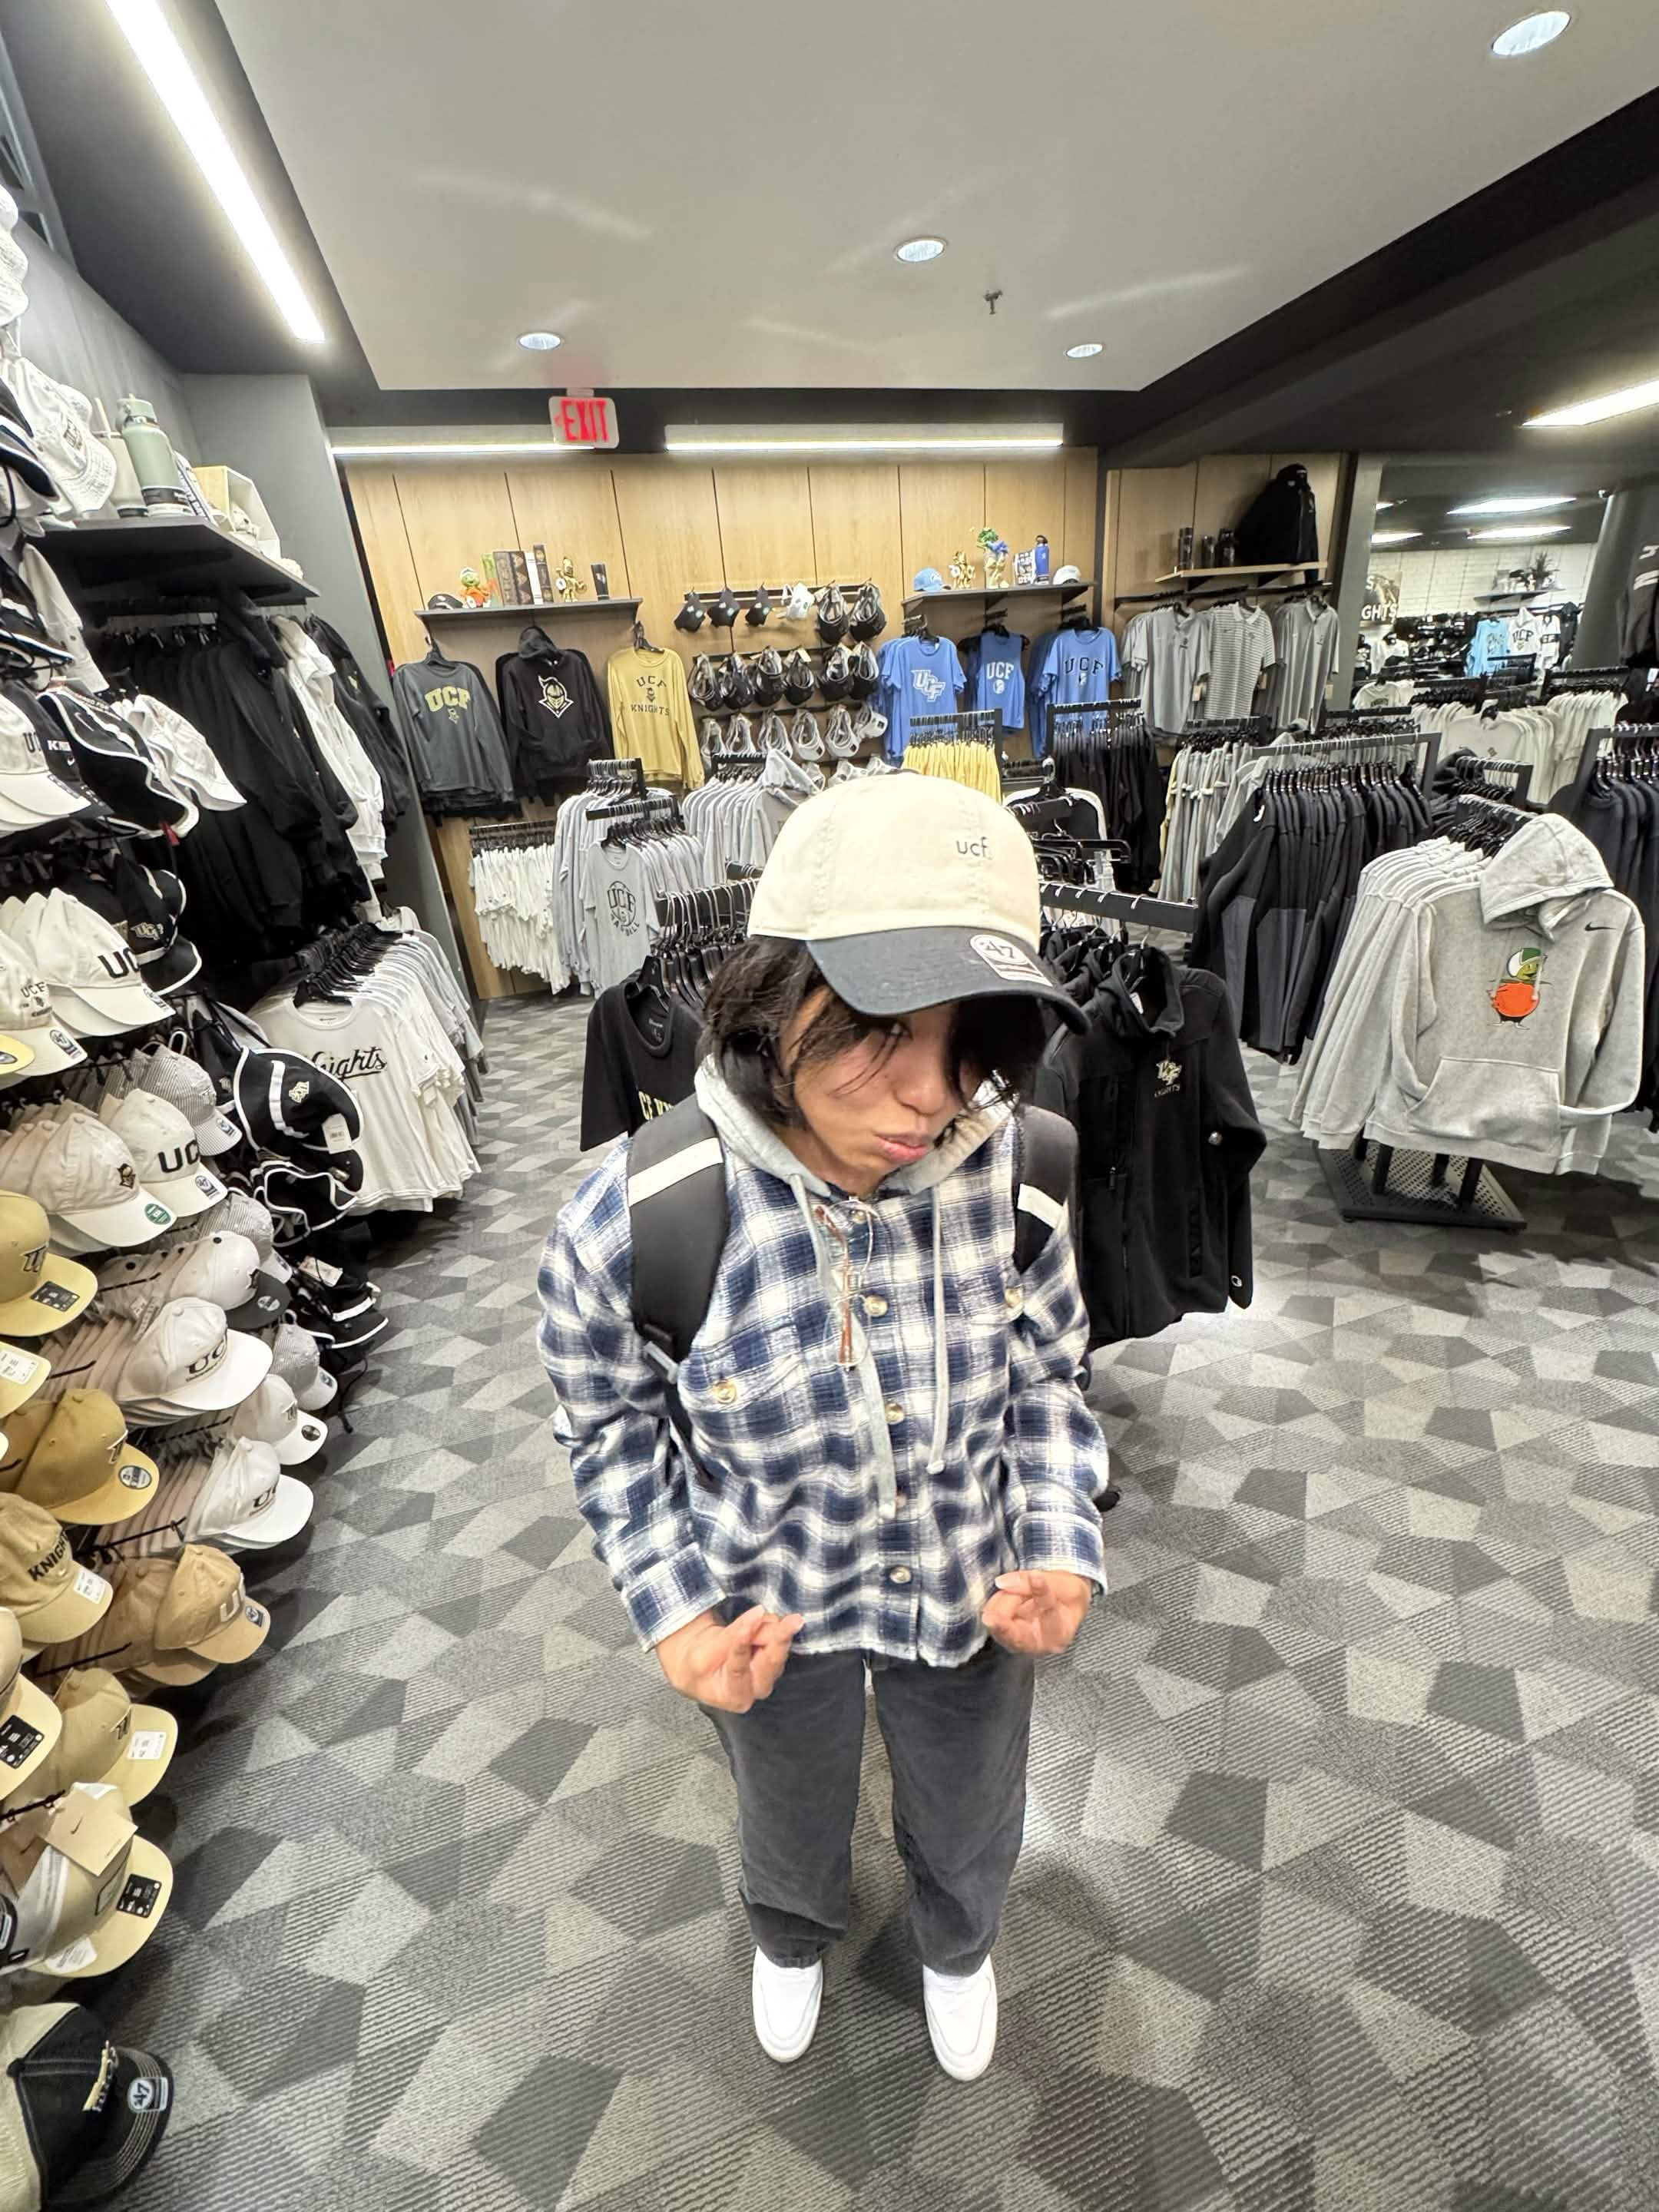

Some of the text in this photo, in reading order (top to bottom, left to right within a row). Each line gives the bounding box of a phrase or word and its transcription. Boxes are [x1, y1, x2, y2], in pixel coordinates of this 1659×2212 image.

[559, 398, 608, 442] EXIT
[986, 661, 1015, 680] UCF
[1063, 657, 1104, 675] UCF
[636, 675, 667, 688] UCF
[909, 669, 946, 703] UCF
[424, 686, 471, 713] UCF
[631, 704, 671, 717] KNIGHTS
[955, 836, 988, 858] ucf
[607, 888, 637, 913] UCF
[310, 1046, 388, 1082] ights
